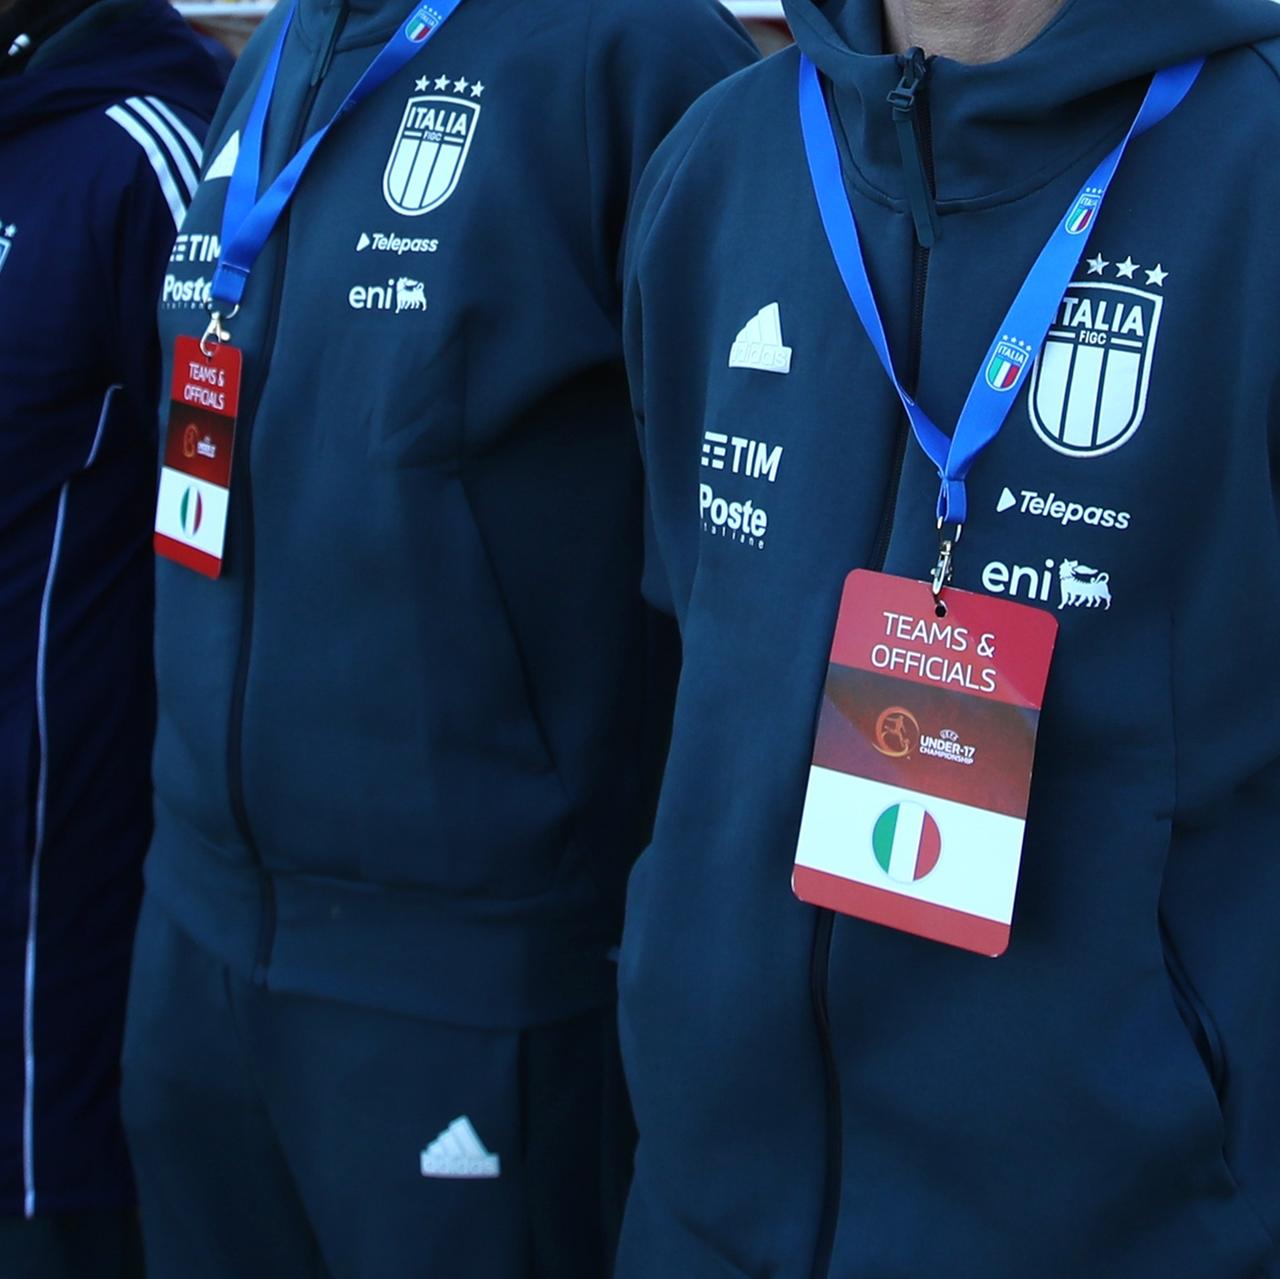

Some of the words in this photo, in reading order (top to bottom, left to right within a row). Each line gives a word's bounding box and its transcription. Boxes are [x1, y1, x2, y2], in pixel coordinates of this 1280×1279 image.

[406, 106, 467, 136] ITALIA
[371, 232, 439, 255] Telepass
[348, 278, 395, 309] eni
[1053, 297, 1145, 337] TALIA
[1079, 329, 1107, 345] FIGC
[998, 346, 1025, 364] ITALIA
[189, 361, 217, 385] TEAMS
[184, 384, 225, 410] OFFICIALS
[731, 436, 784, 482] TIM
[699, 483, 768, 537] Poste
[1020, 490, 1131, 529] Telepass
[982, 558, 1055, 601] eni
[883, 611, 969, 652] TEAMS
[977, 633, 995, 658] &
[871, 644, 997, 692] OFFICIALS
[920, 734, 976, 758] UNDER-17
